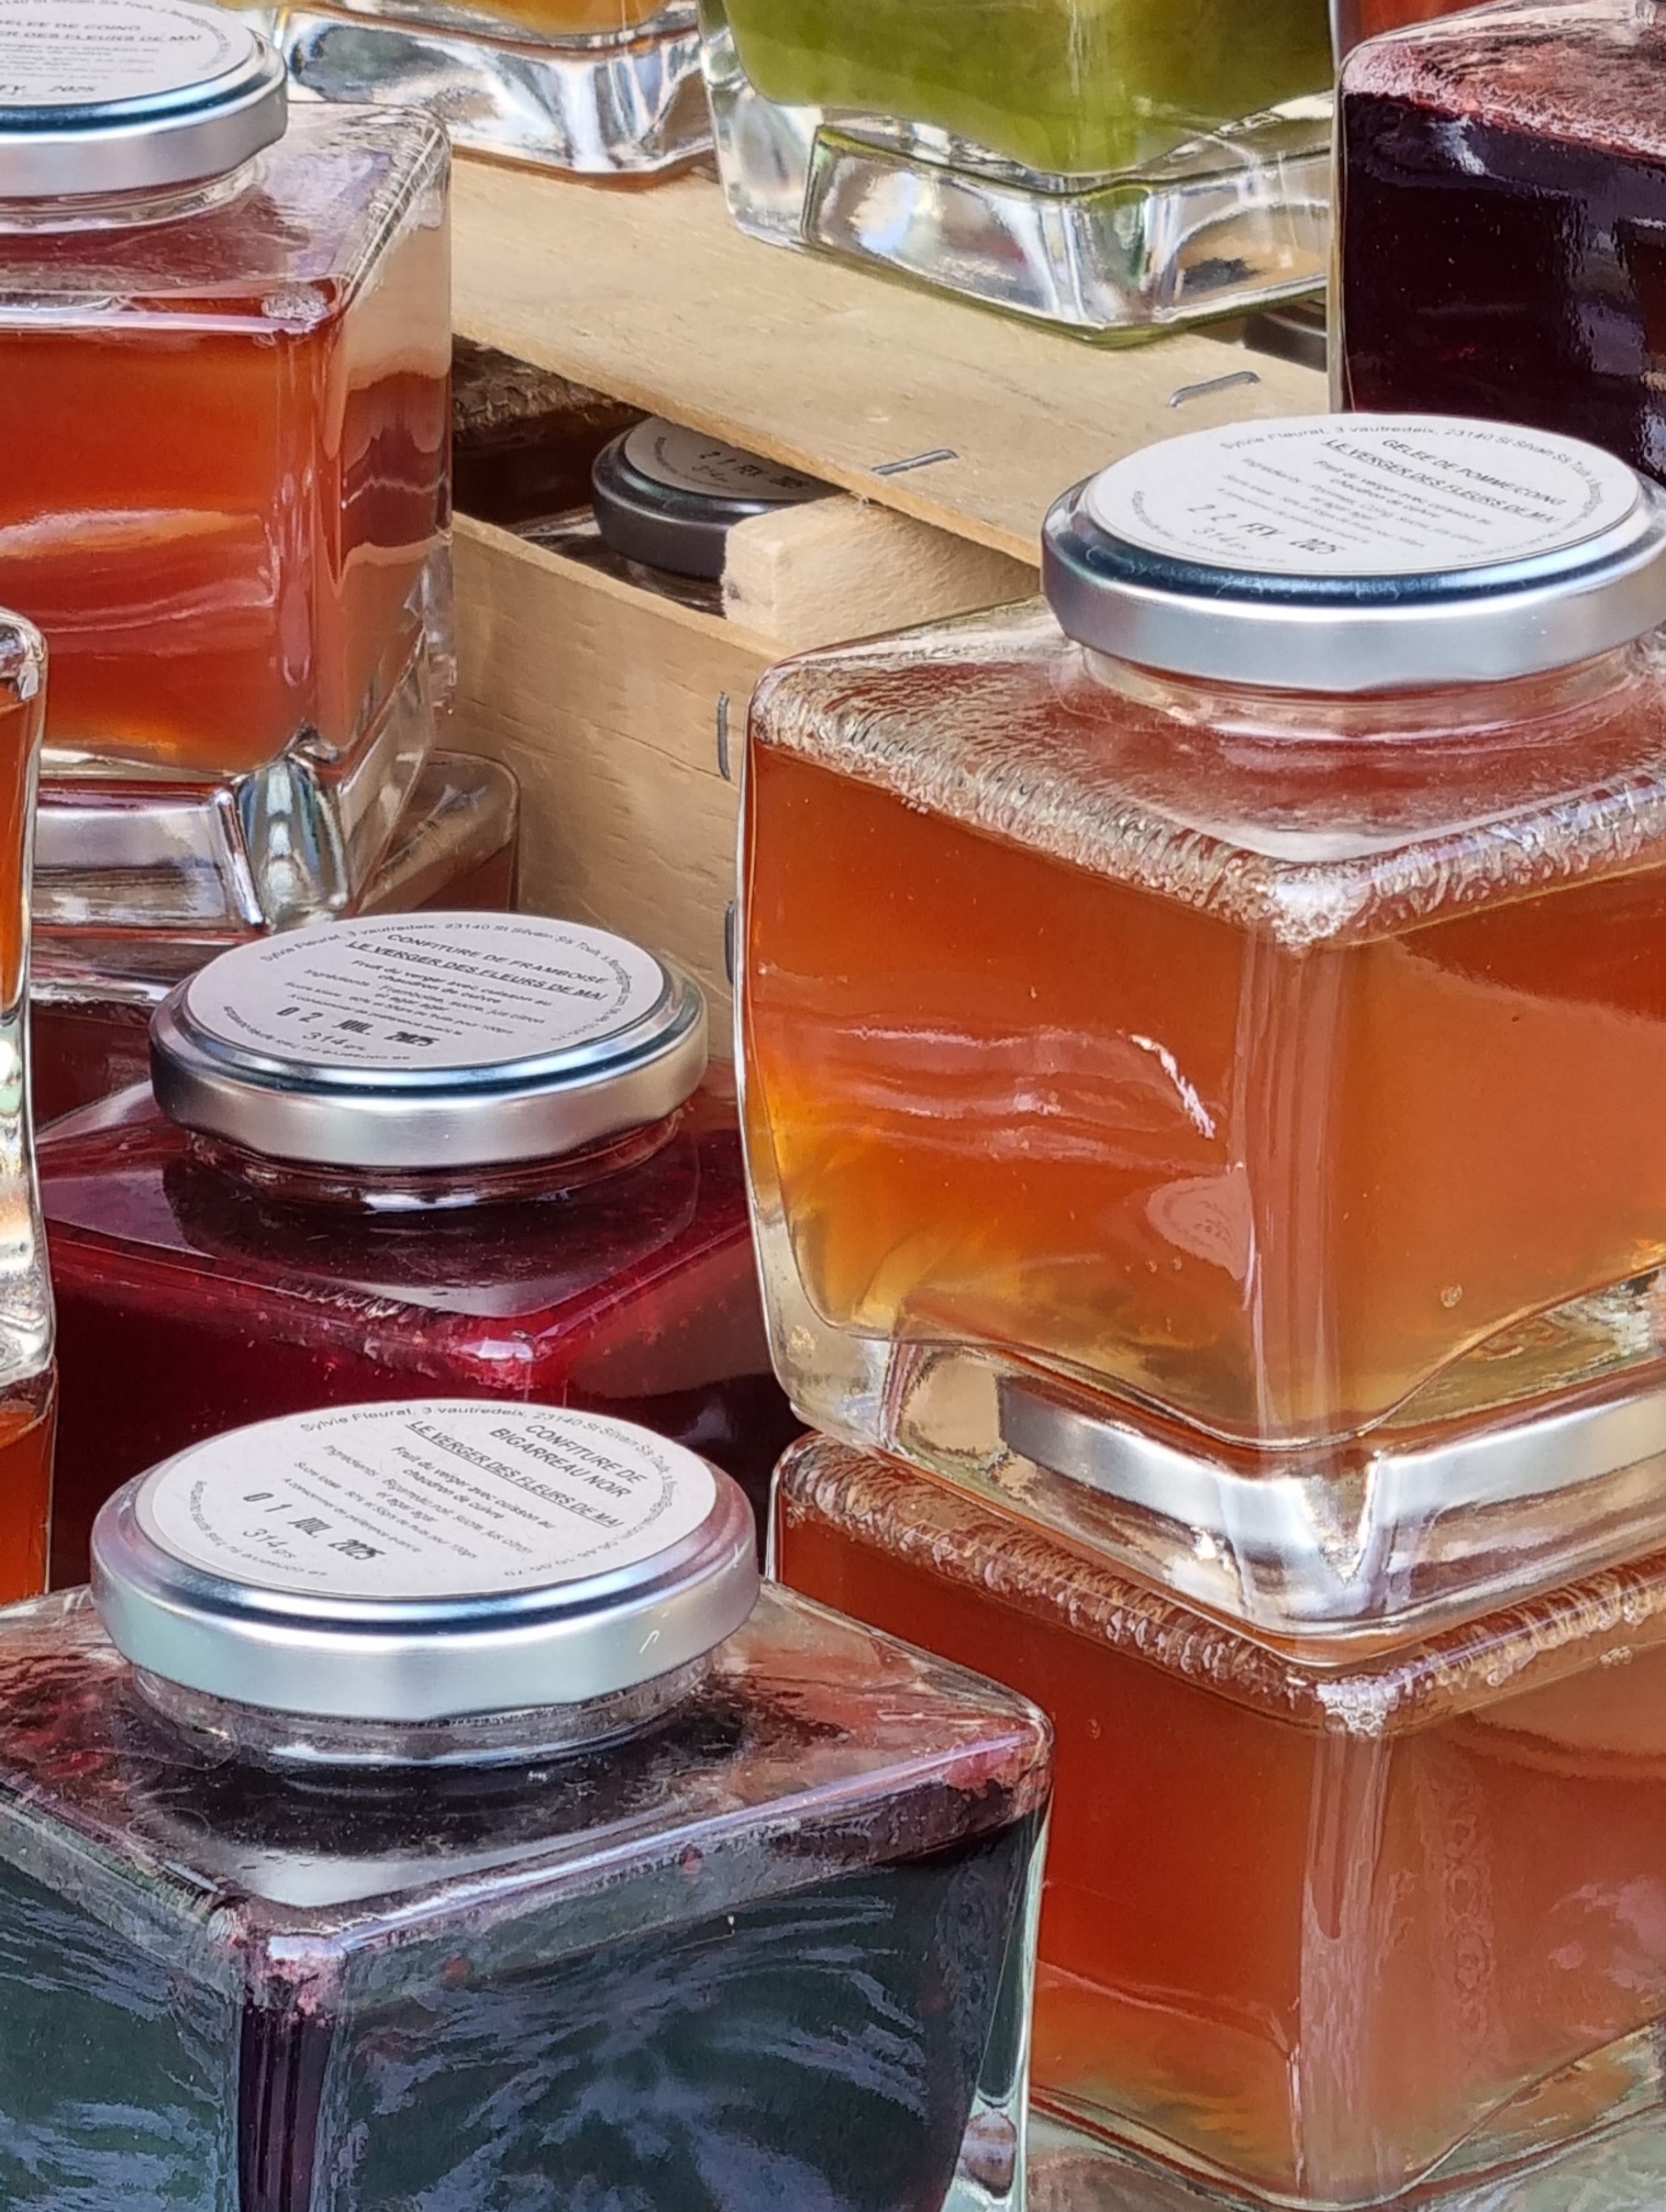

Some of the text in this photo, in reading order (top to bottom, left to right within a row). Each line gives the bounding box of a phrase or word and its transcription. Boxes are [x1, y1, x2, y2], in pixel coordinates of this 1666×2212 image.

[1324, 439, 1352, 451] LE
[1349, 449, 1413, 479] VERGER
[1410, 472, 1447, 486] DES
[1444, 484, 1507, 506] FLEURS
[1504, 504, 1528, 516] DE
[1382, 439, 1436, 461] GELEE
[1433, 460, 1459, 470] DE
[348, 940, 608, 1001] LE VERGER DES FLEURS DE MAI
[387, 933, 482, 958] CONFITURE
[483, 953, 507, 962] DE
[509, 960, 609, 984] FRAMBOISE
[300, 1416, 349, 1432] Sylvie
[422, 1406, 432, 1415] 3
[534, 1411, 583, 1426] 23140
[391, 1446, 420, 1462] Fruit
[418, 1461, 435, 1470] du
[434, 1469, 471, 1488] verger
[468, 1485, 497, 1501] avec
[495, 1498, 539, 1521] cuisson
[410, 1420, 435, 1435] LE
[432, 1431, 492, 1463] VERGER
[485, 1460, 521, 1478] DES
[516, 1472, 576, 1506] FLEURS
[572, 1502, 597, 1515] DE
[594, 1512, 625, 1527] MAI
[489, 1428, 589, 1477] BIGARREAU
[583, 1475, 632, 1497] NOIR
[526, 1424, 648, 1484] CONFITURE DE
[403, 1468, 505, 1519] chaudron de cuivre
[328, 1539, 386, 1561] 2025
